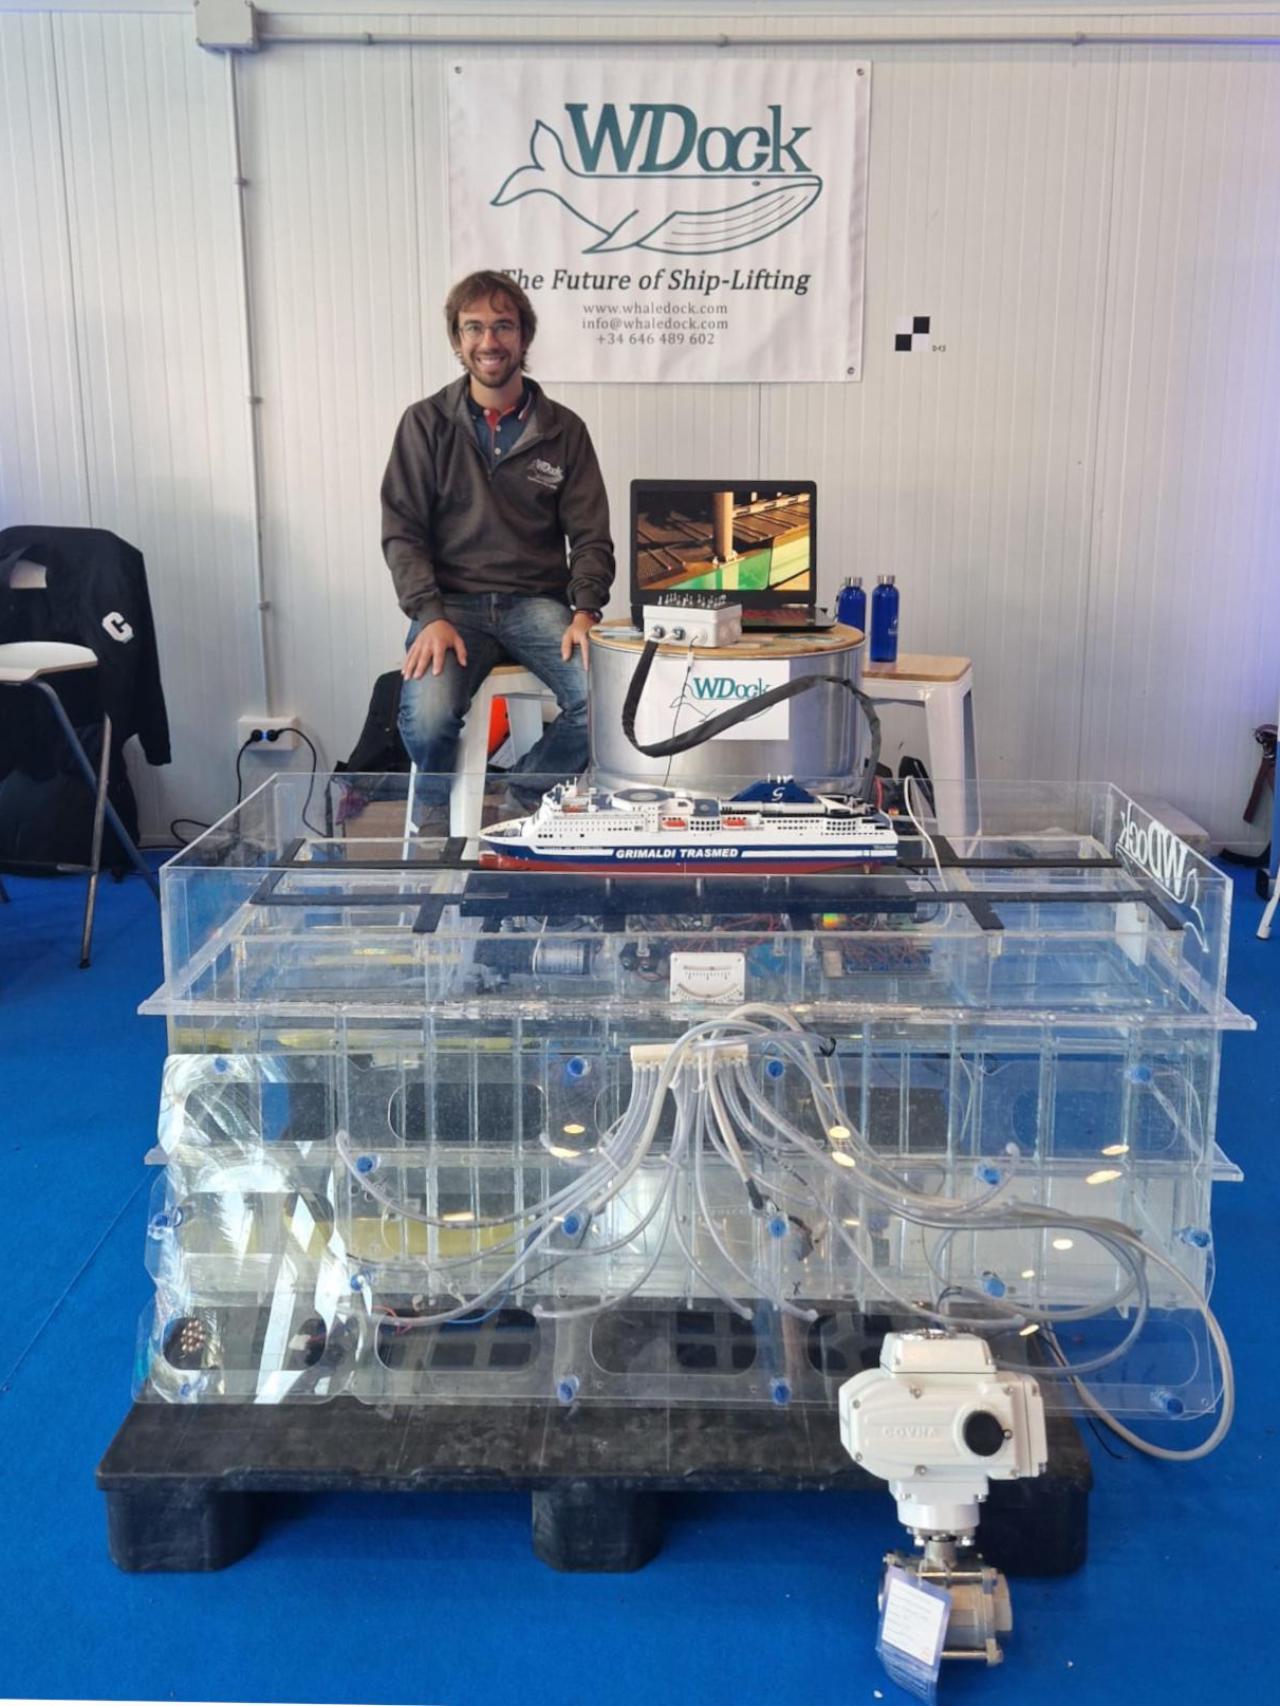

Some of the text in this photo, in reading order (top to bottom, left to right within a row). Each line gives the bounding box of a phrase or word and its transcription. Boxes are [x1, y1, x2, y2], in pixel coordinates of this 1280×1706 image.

[565, 103, 813, 172] WDock
[501, 268, 811, 296] The Future of Ship-Lifting
[583, 301, 728, 315] www.whaledock.com
[582, 317, 729, 330] info@whaledock.com
[597, 333, 715, 345] +34 646 489 602
[693, 677, 772, 699] WDock
[615, 848, 739, 859] GRIMALDI TRASMED
